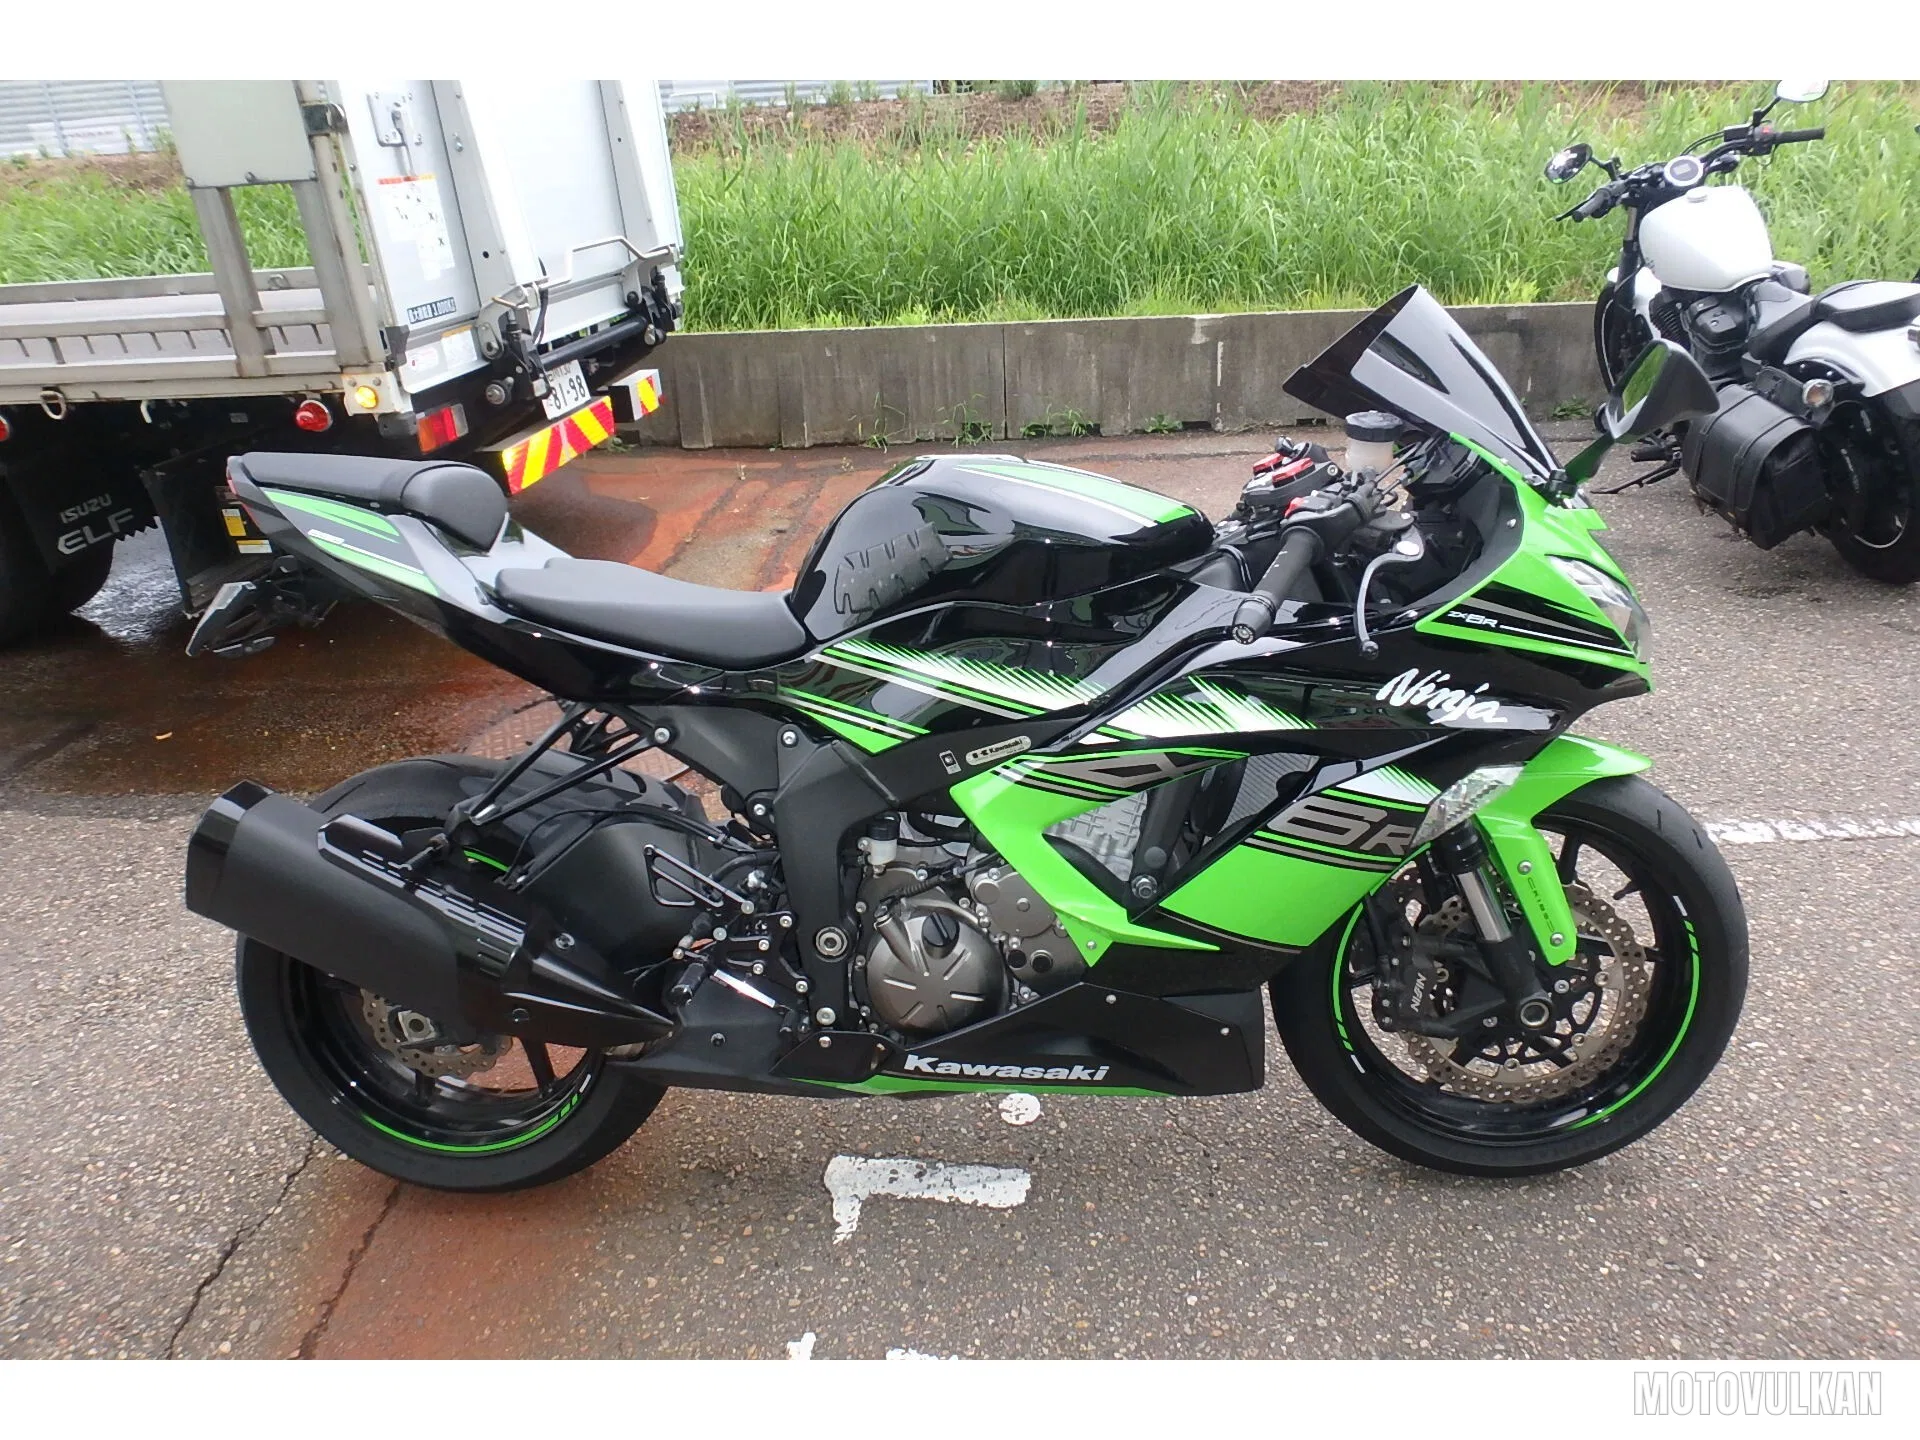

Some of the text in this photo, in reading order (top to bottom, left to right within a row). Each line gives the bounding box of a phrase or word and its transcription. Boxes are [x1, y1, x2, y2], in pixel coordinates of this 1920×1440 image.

[550, 374, 586, 410] 81-98
[60, 493, 112, 524] ISUZU
[57, 507, 134, 555] ELF
[1375, 667, 1508, 725] Ninja
[1266, 795, 1417, 856] 6R
[903, 1054, 1110, 1081] Kawasaki
